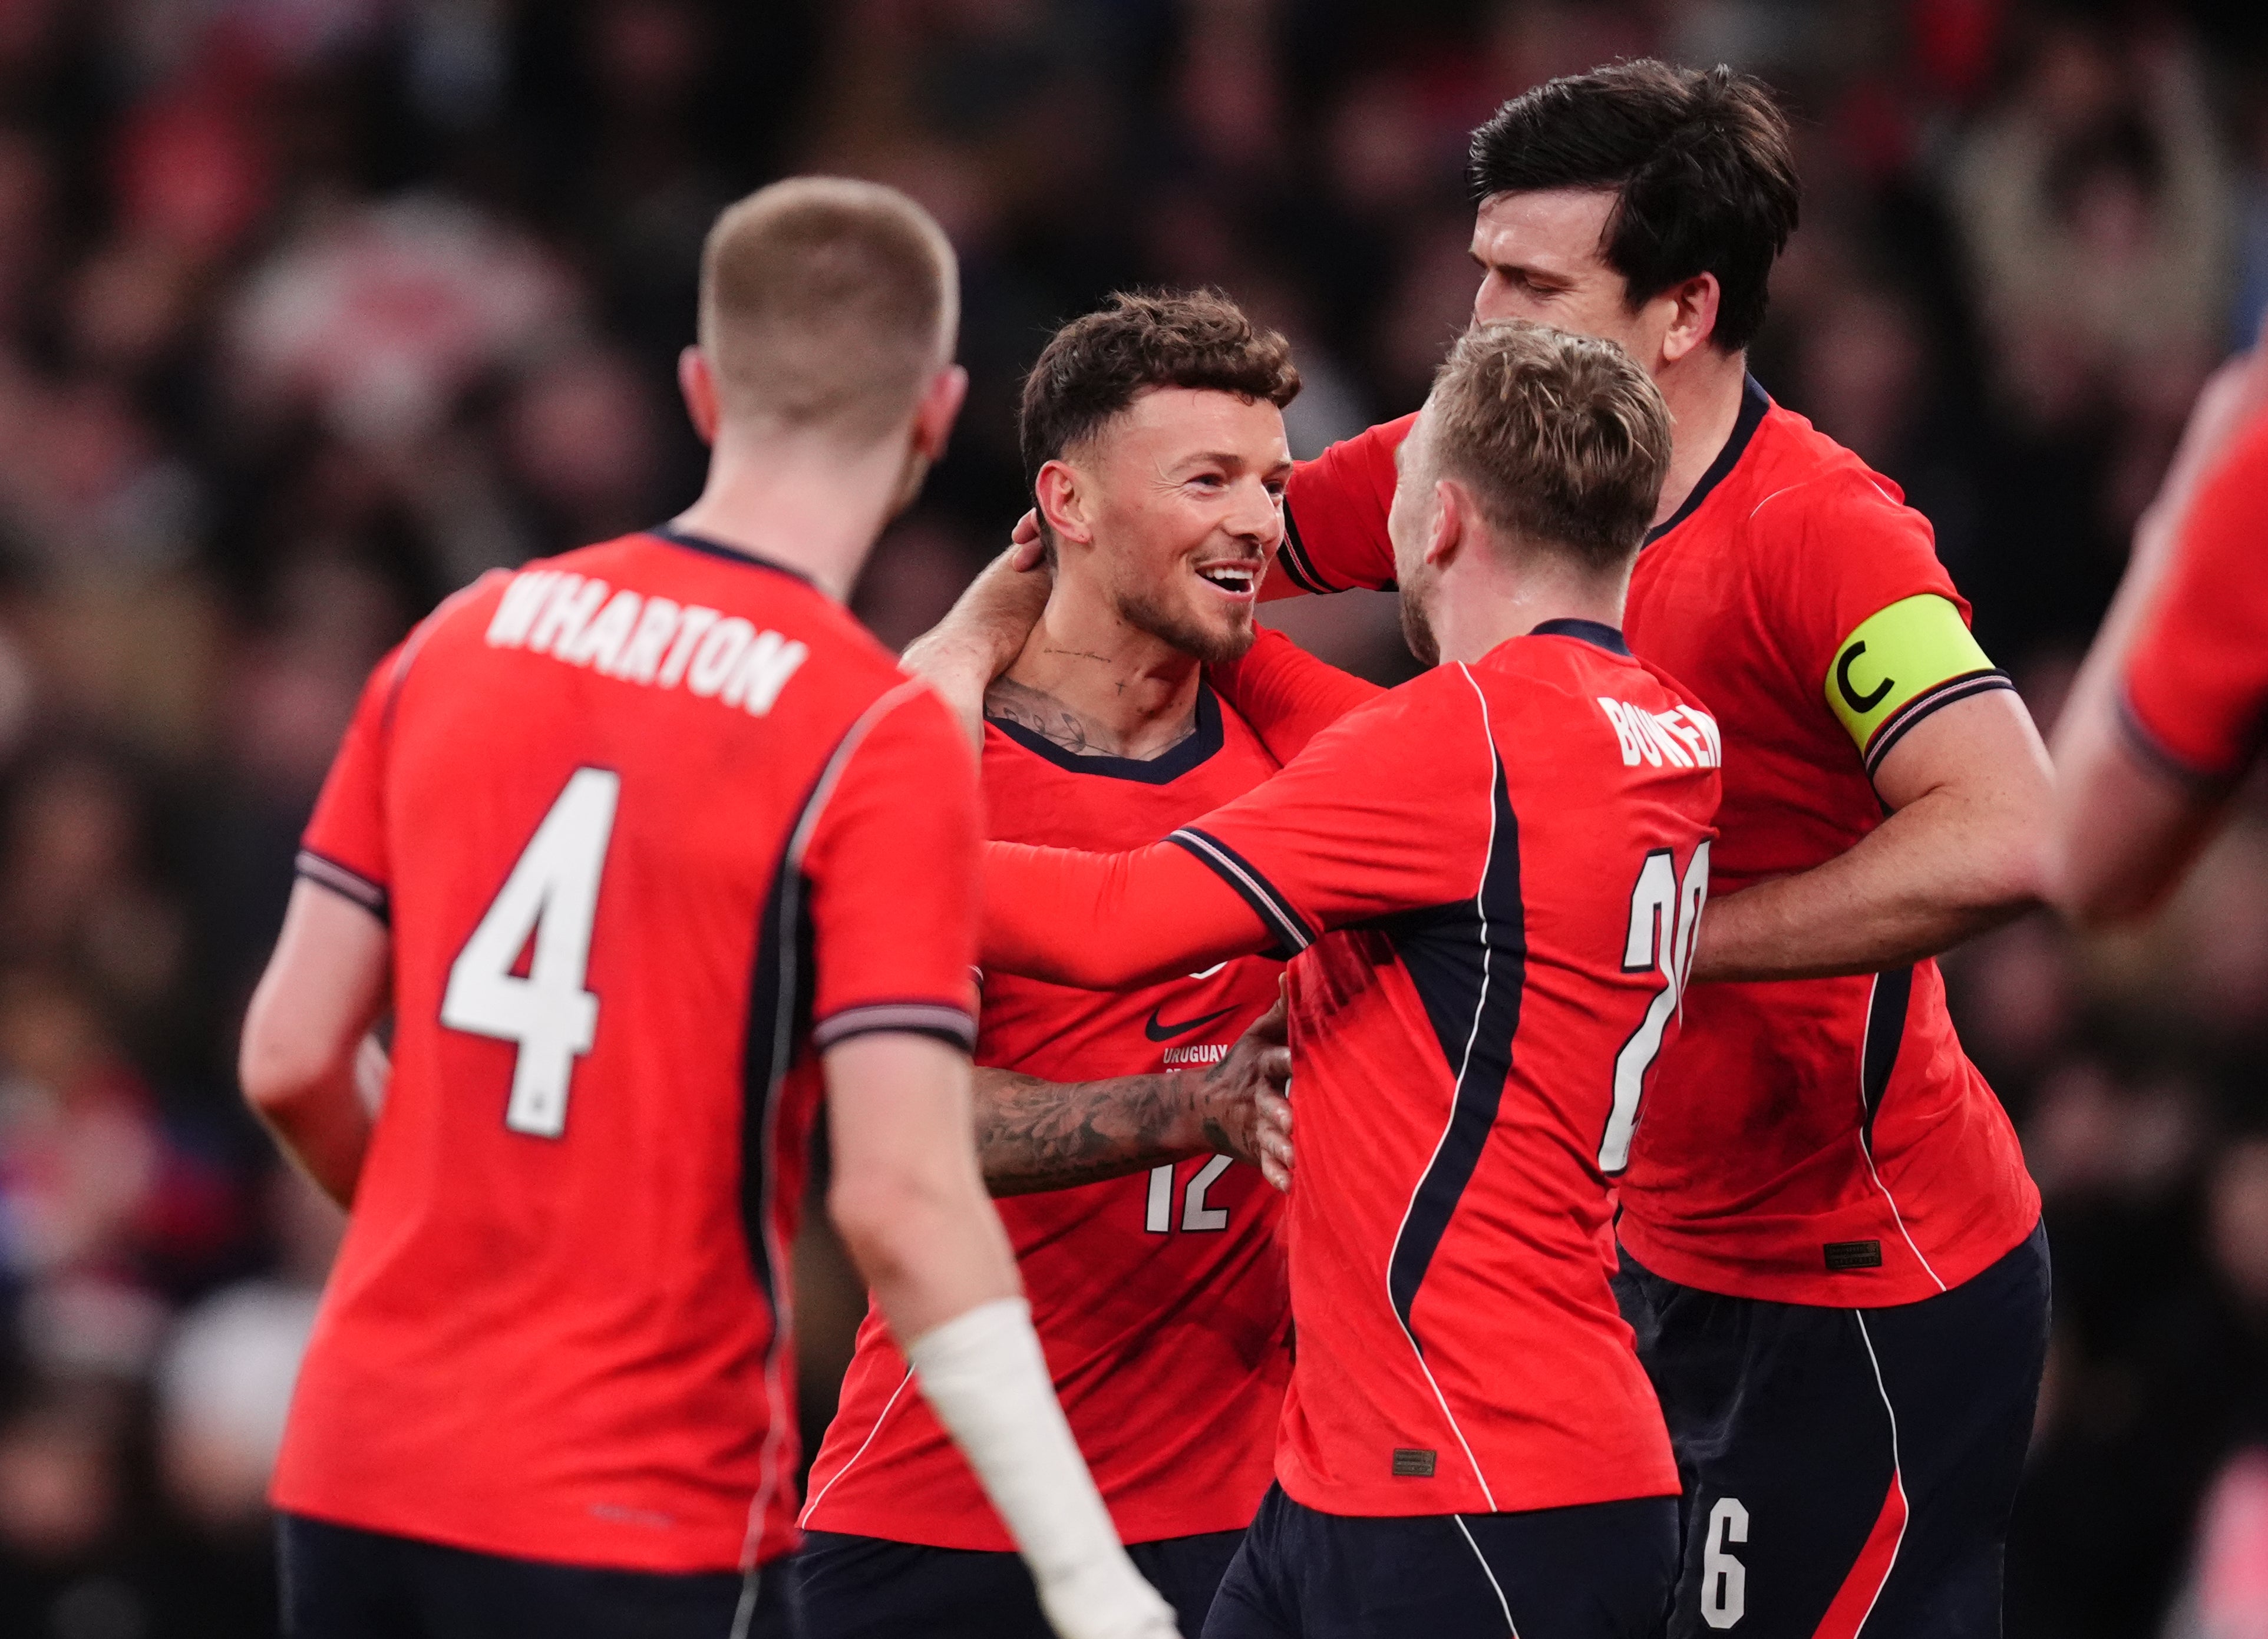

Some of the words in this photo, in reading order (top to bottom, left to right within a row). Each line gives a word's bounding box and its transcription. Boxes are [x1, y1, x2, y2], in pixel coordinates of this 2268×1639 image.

[486, 570, 808, 718] WHARTON
[1837, 640, 1895, 713] C
[1596, 696, 1722, 768] BOWEN
[440, 765, 620, 1139] 4
[1163, 1044, 1228, 1064] URUGUAY
[1701, 1497, 1749, 1629] 6
